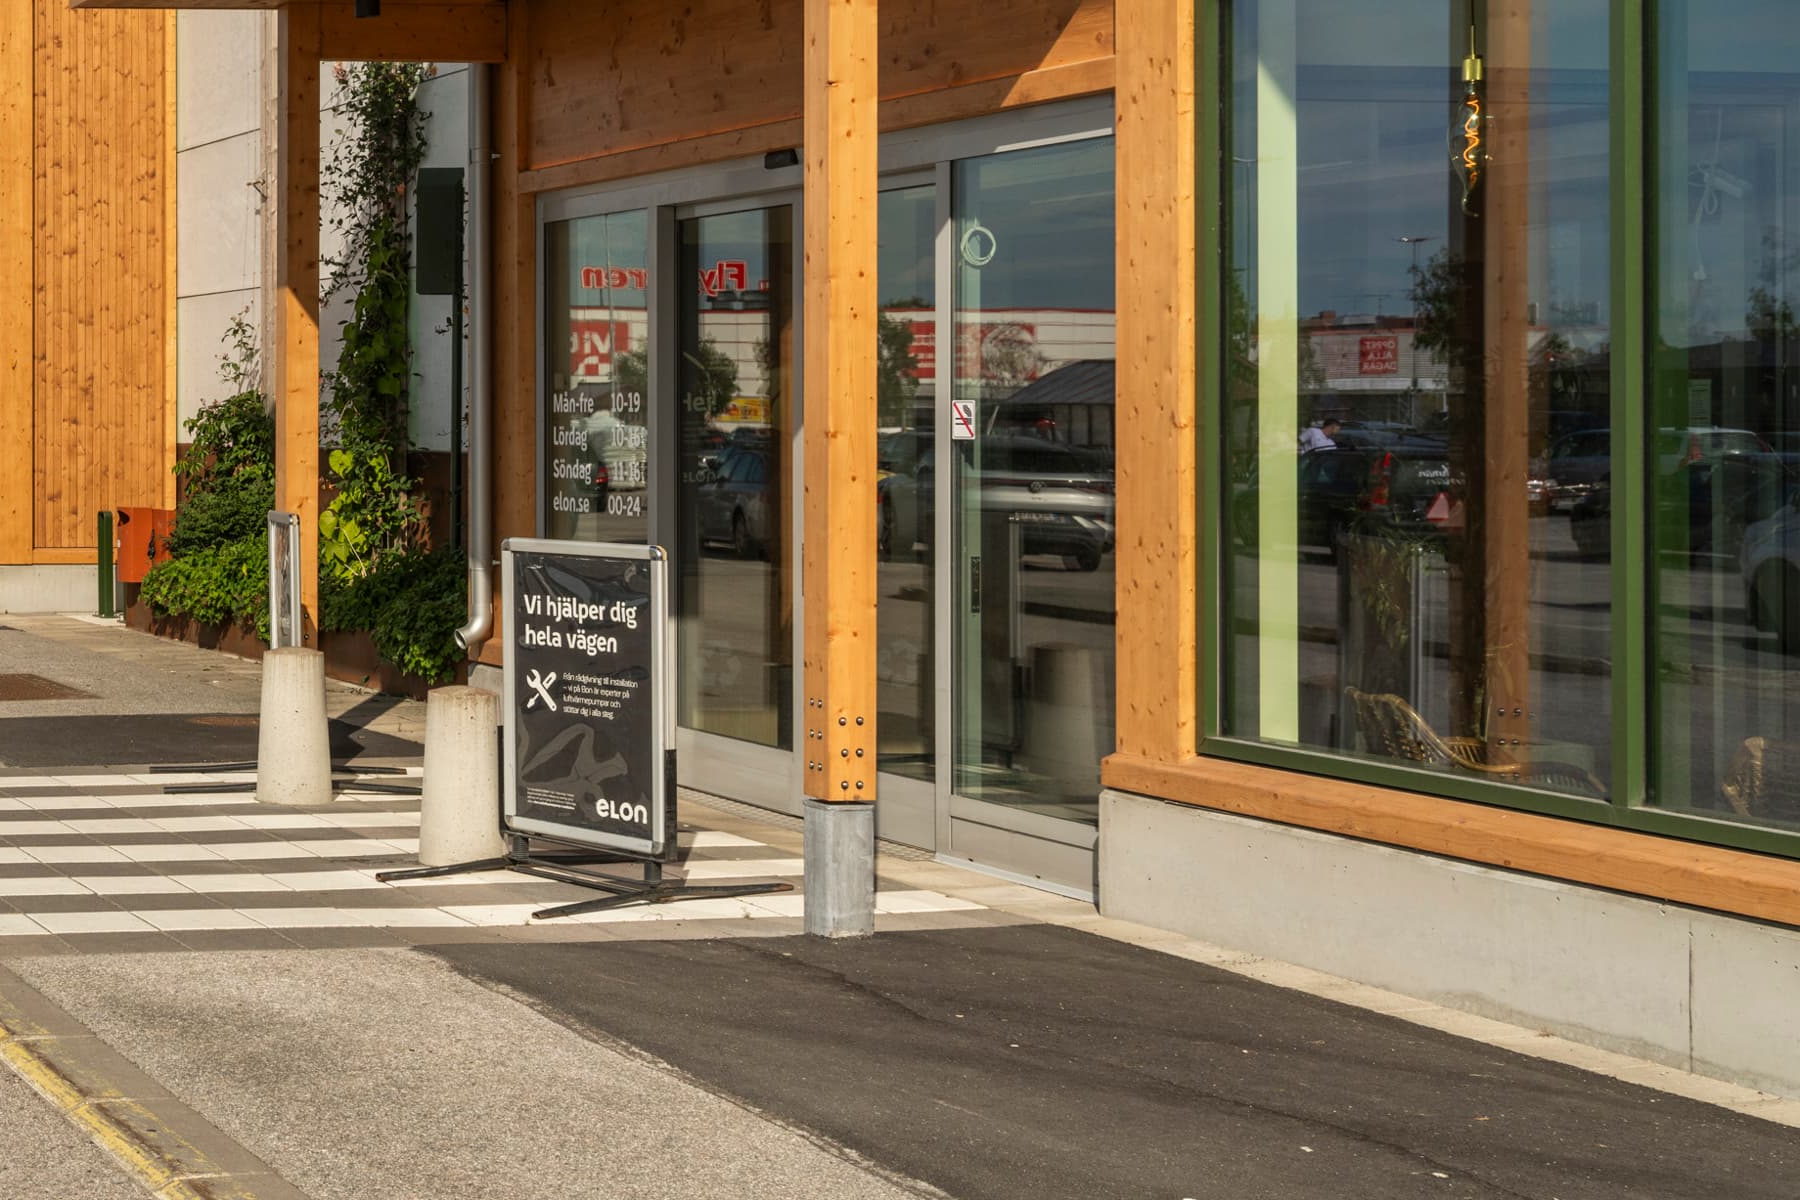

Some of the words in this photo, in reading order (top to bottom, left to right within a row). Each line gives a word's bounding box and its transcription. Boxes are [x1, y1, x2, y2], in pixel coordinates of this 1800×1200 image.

[553, 392, 594, 413] Mån-fre
[611, 392, 640, 413] 10-19
[553, 427, 588, 451] Lördag
[553, 460, 592, 484] Söndag
[553, 491, 590, 513] elon.se
[608, 495, 641, 517] 00-24
[524, 594, 541, 615] Vi
[546, 595, 605, 624] hjälper
[610, 601, 638, 629] dig
[525, 623, 562, 647] hela
[566, 629, 617, 656] vägen
